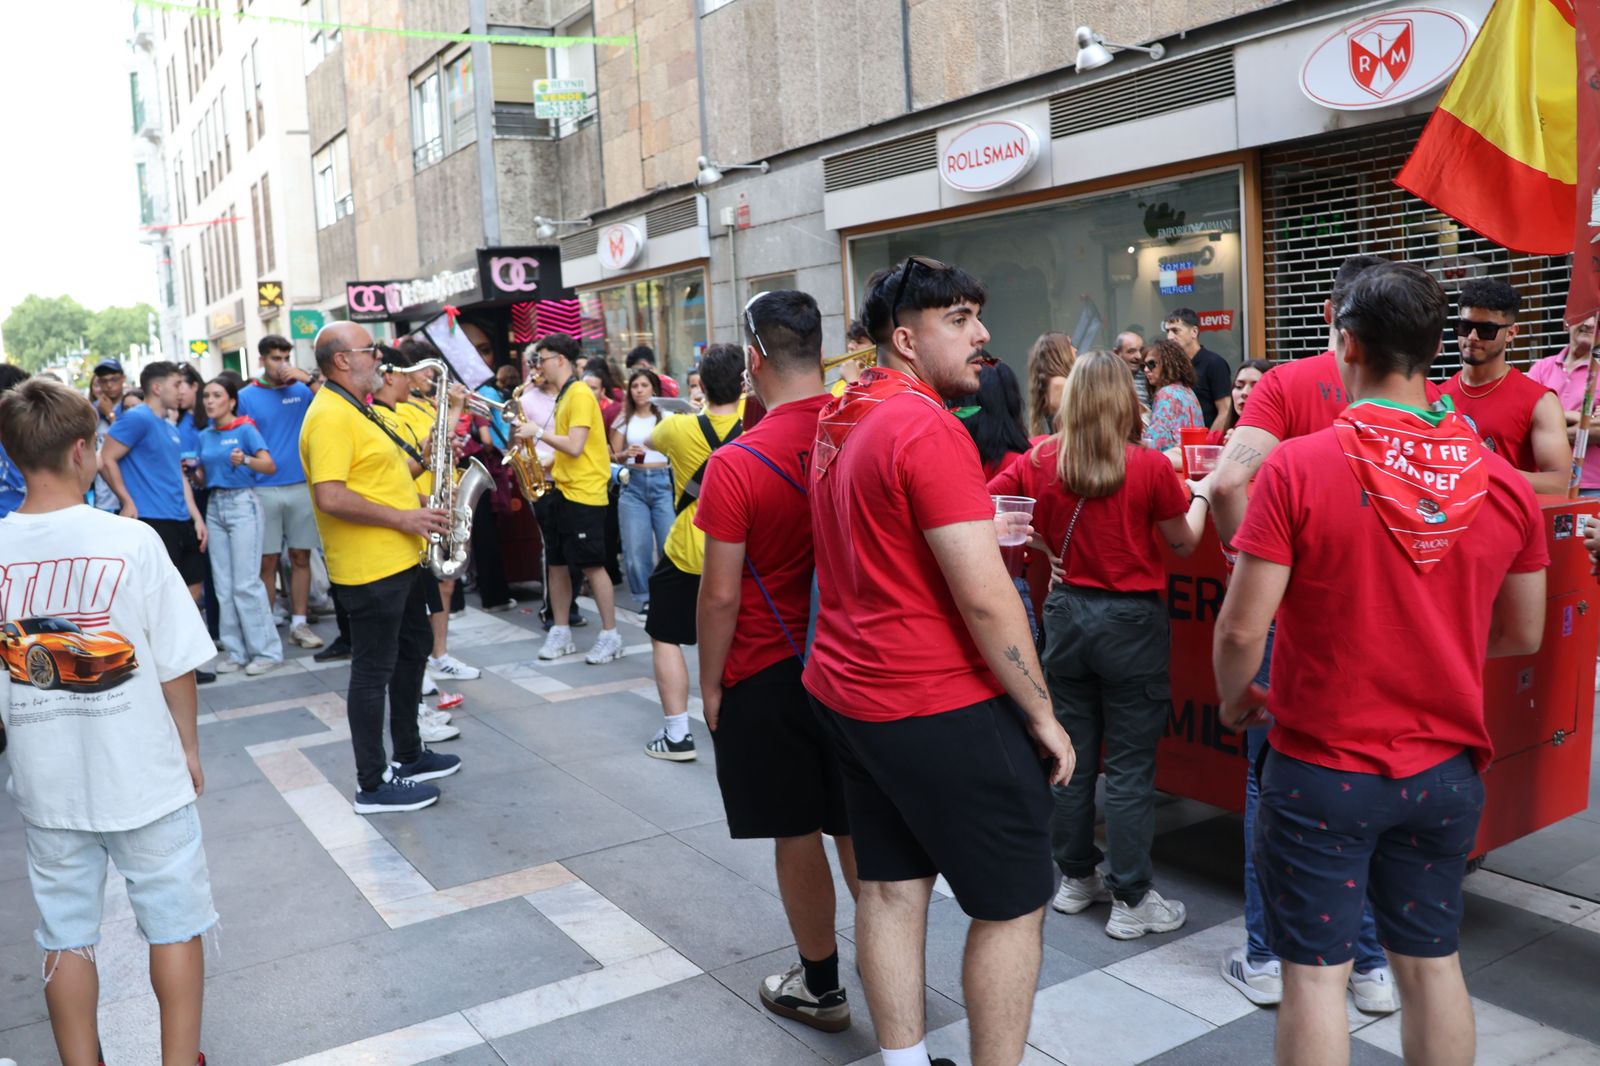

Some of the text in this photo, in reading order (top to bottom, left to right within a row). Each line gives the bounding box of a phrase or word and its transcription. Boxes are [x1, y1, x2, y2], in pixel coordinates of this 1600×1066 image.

[1359, 47, 1407, 73] R M
[947, 137, 1024, 174] ROLLSMAN
[1161, 285, 1193, 295] HILFIGER
[1422, 442, 1433, 460] Y
[1439, 445, 1470, 462] FIE
[1412, 538, 1449, 549] ZAMORA
